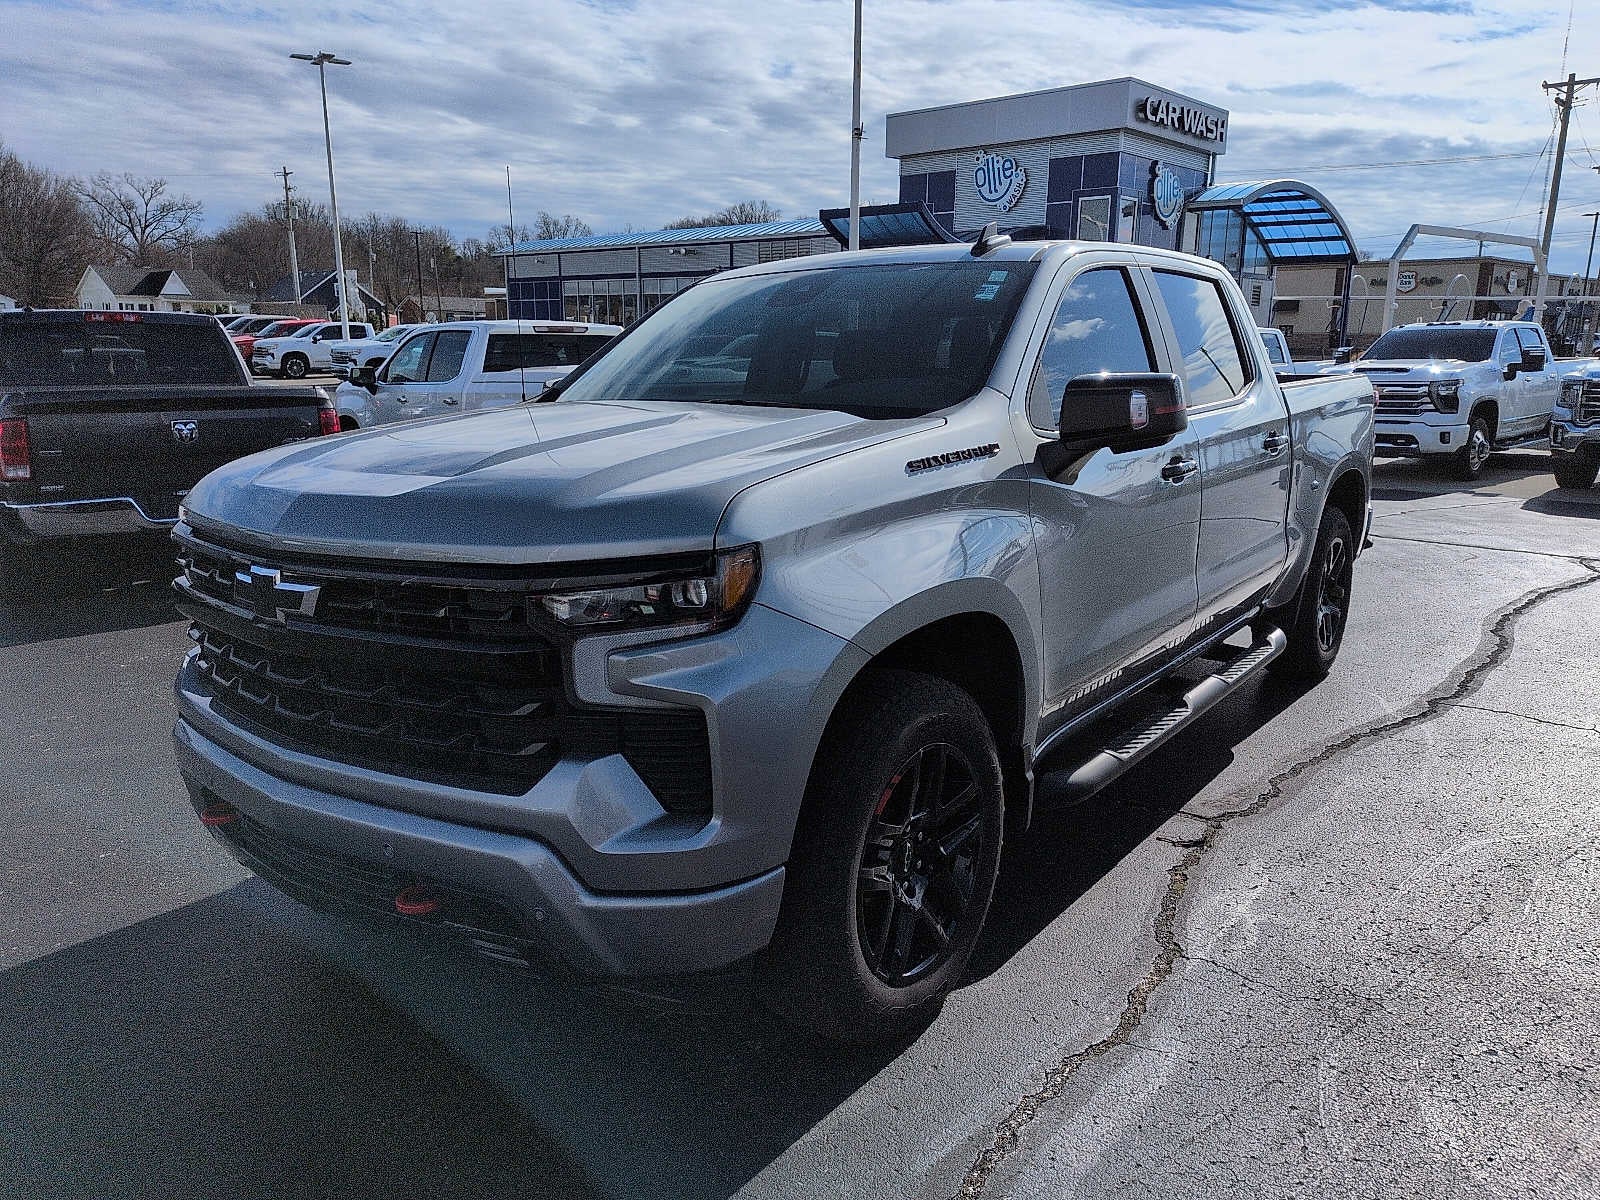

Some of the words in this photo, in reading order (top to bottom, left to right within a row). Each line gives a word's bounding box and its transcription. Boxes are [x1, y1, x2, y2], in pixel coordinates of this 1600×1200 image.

[1144, 96, 1179, 128] CAR
[1183, 106, 1227, 142] WASH
[975, 156, 1014, 194] ollie
[1007, 182, 1024, 206] WASH
[1157, 170, 1180, 208] ollie
